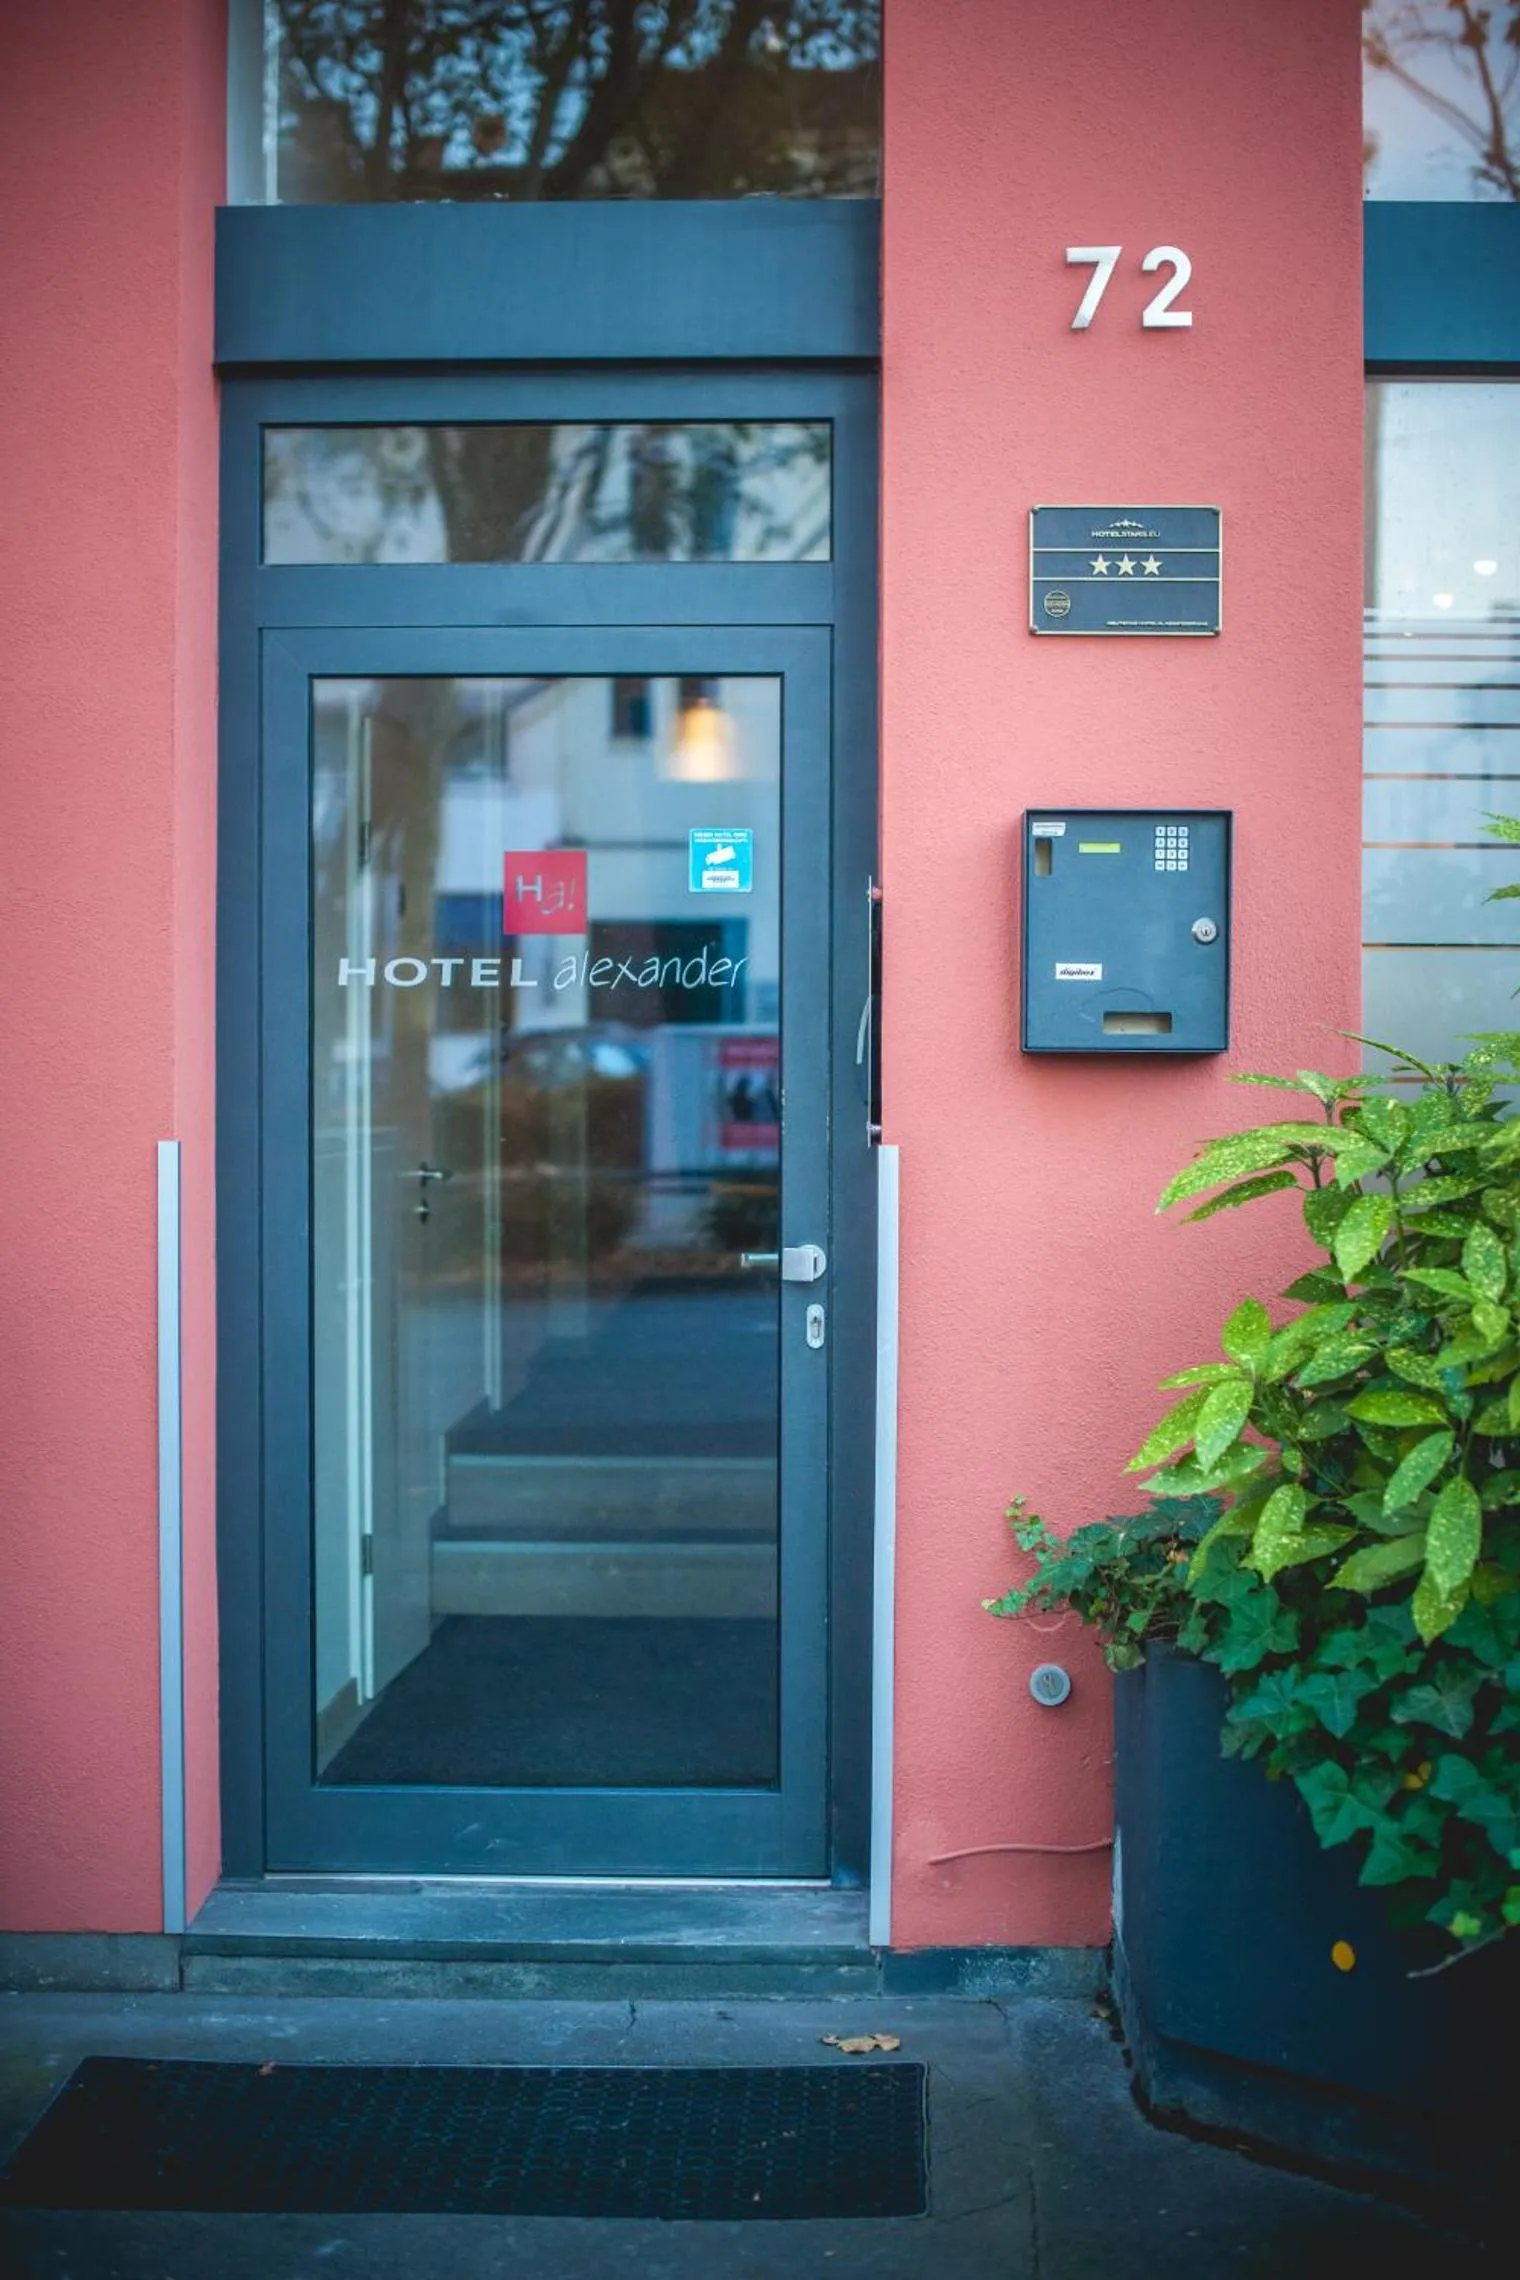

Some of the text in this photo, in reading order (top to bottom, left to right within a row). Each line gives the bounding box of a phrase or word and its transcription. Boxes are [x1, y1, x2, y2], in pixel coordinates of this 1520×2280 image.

[1066, 245, 1193, 329] 72
[516, 872, 577, 915] Ha!
[338, 946, 749, 991] HOTEL alexander
